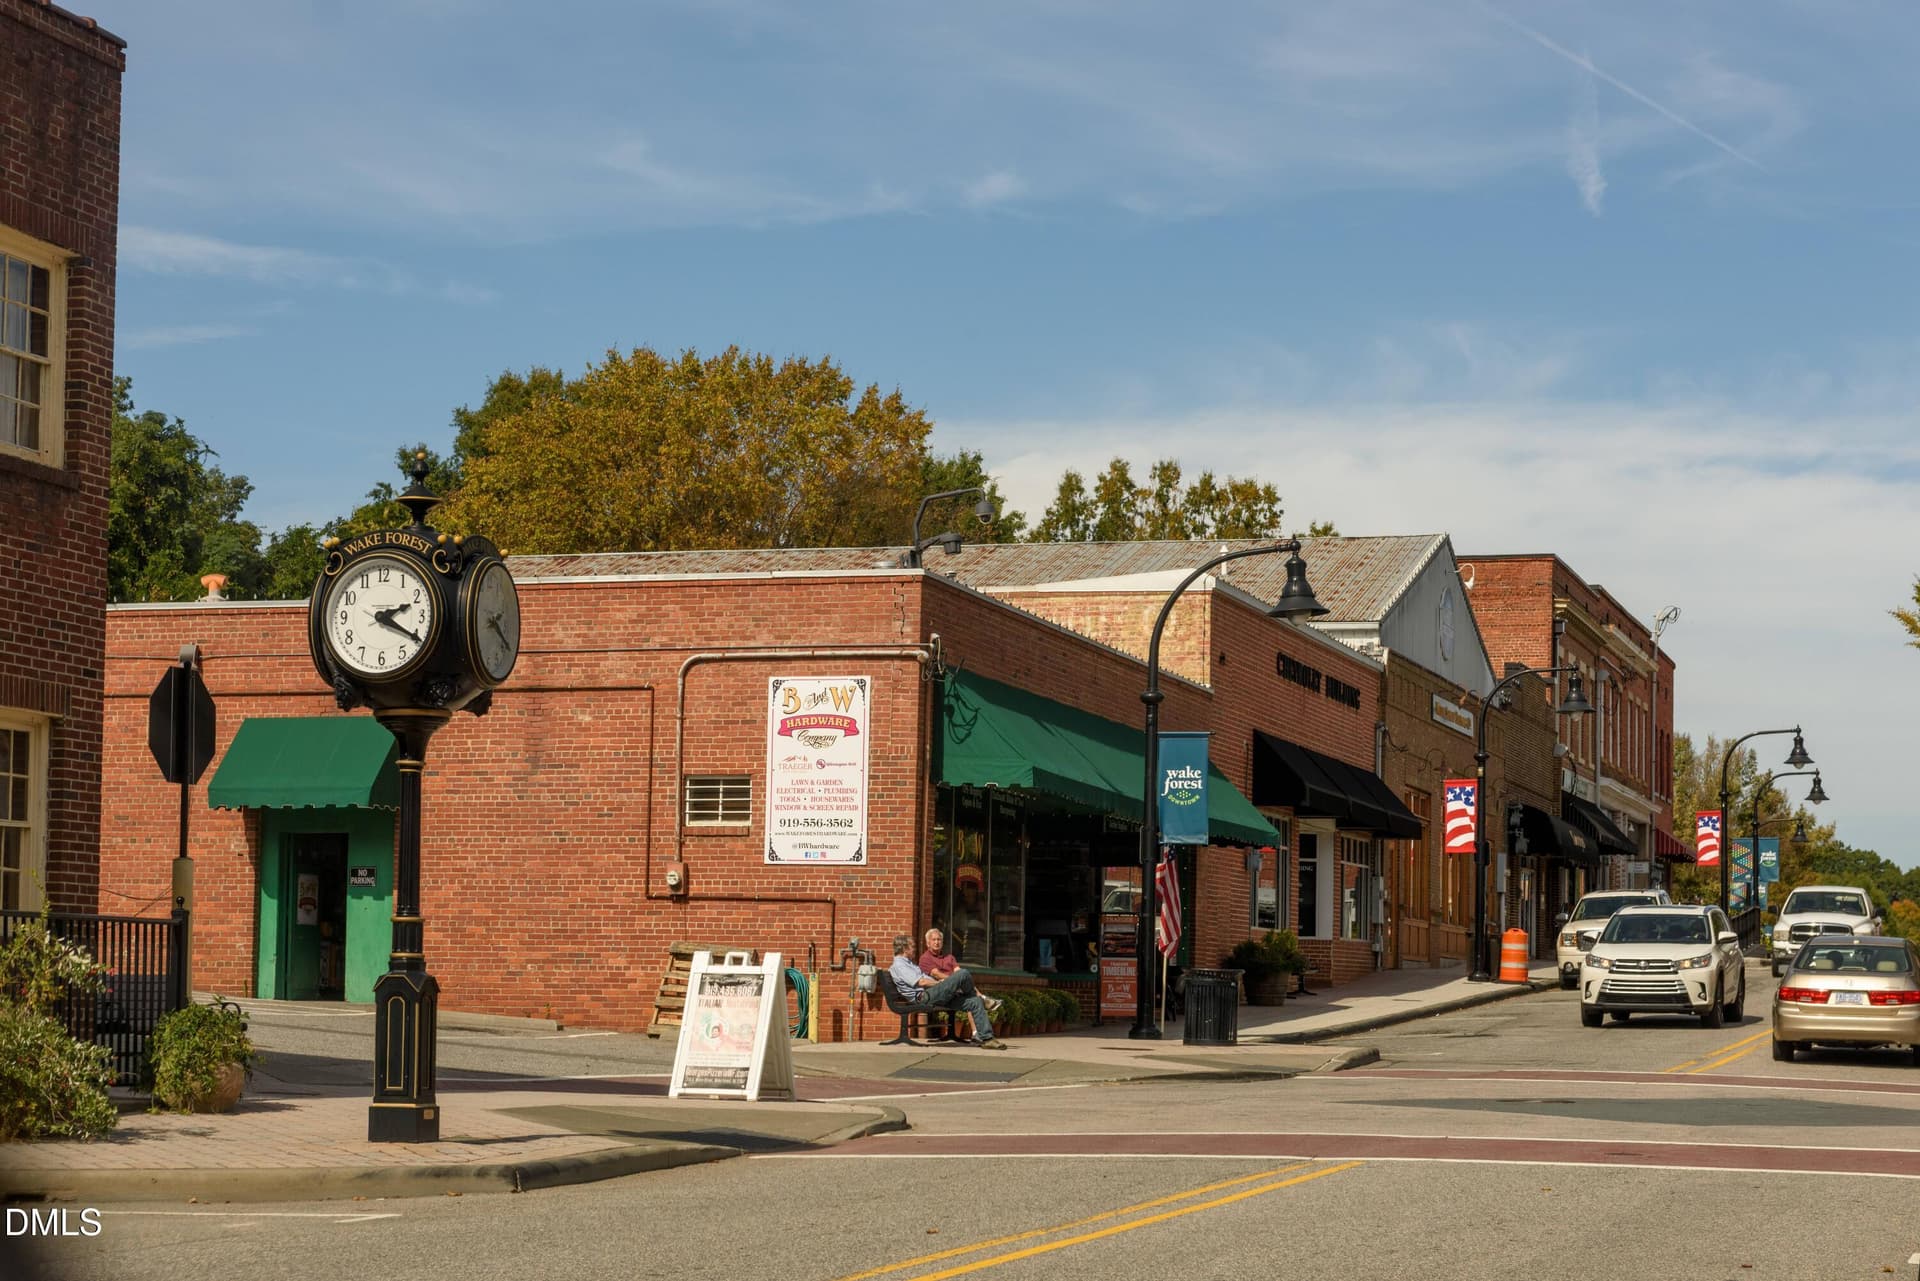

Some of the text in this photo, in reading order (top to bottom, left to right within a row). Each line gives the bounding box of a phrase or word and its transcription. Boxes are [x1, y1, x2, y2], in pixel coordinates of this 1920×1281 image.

[344, 532, 433, 556] WAKE FOREST
[360, 574, 369, 589] 11
[378, 568, 390, 582] 12
[400, 574, 406, 588] 1
[344, 591, 356, 606] 10
[413, 588, 421, 604] 2
[340, 610, 348, 625] 9
[418, 609, 425, 624] 3
[344, 629, 353, 645] 8
[358, 646, 366, 661] 7
[378, 650, 386, 666] 6
[398, 644, 407, 660] 5
[782, 686, 802, 715] B
[829, 685, 857, 713] W
[786, 716, 851, 729] HARDWARE
[797, 729, 838, 749] Company
[1166, 765, 1202, 779] wake
[1160, 776, 1204, 797] forest
[779, 818, 854, 828] 919-556-3562
[357, 869, 368, 877] NO
[351, 877, 375, 885] PARKING
